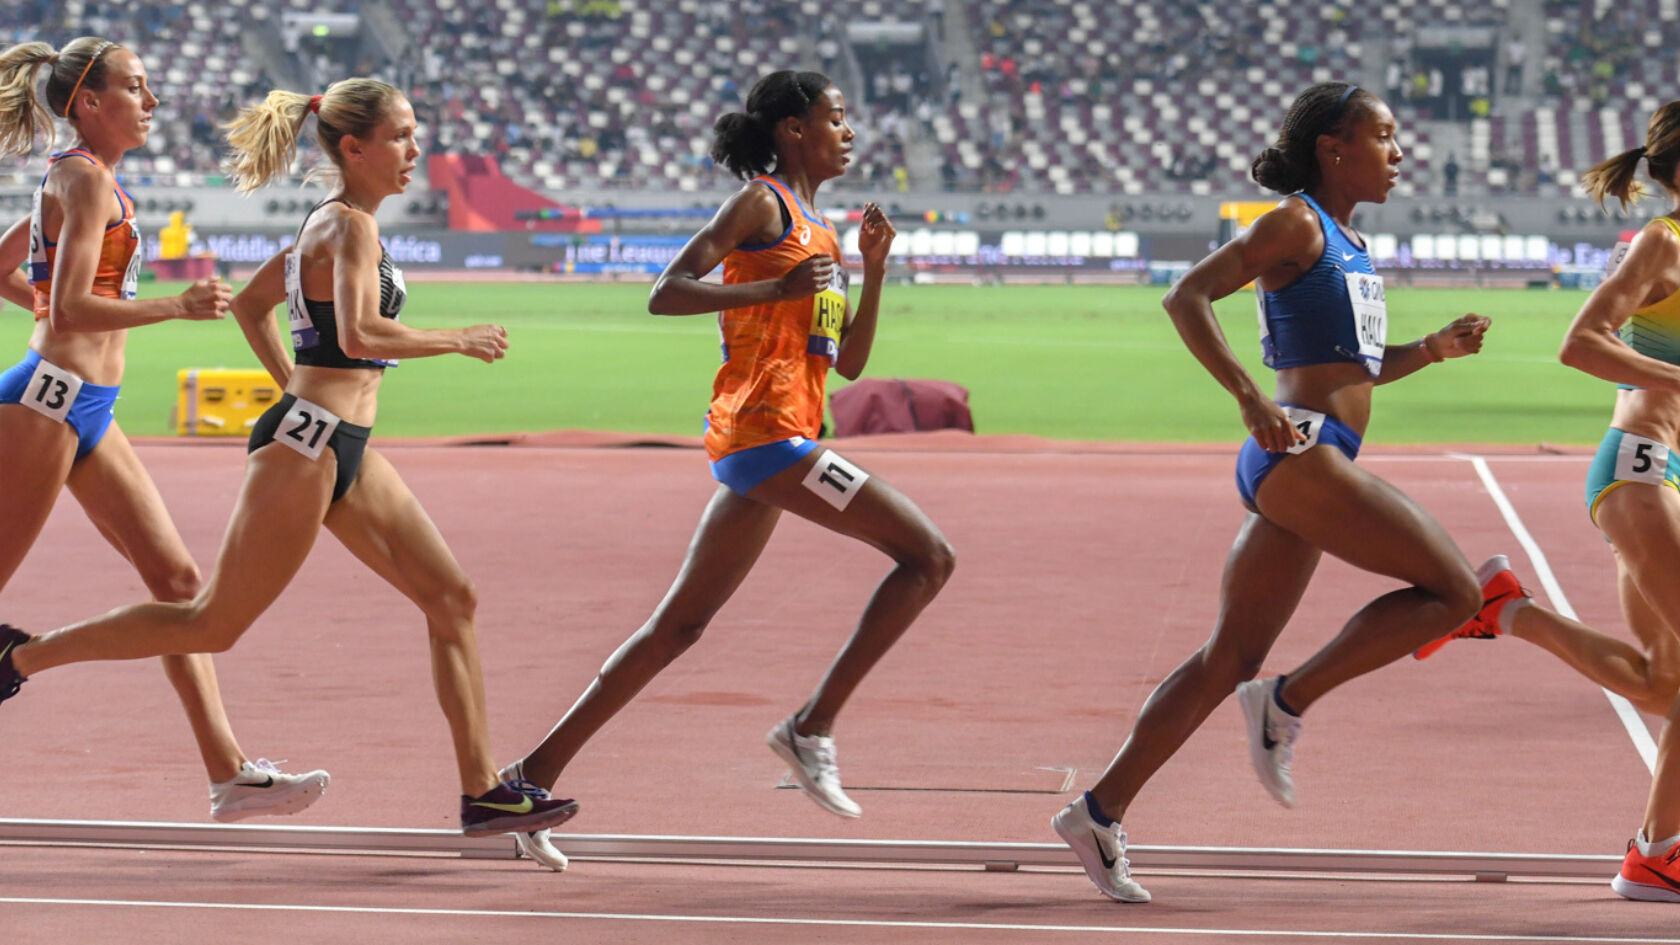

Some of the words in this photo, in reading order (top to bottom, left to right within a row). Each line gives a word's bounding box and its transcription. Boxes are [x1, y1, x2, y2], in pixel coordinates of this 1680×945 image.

[208, 235, 277, 262] Middle
[37, 374, 69, 410] 13
[286, 410, 329, 449] 21
[1632, 443, 1653, 473] 5
[818, 461, 855, 494] 11
